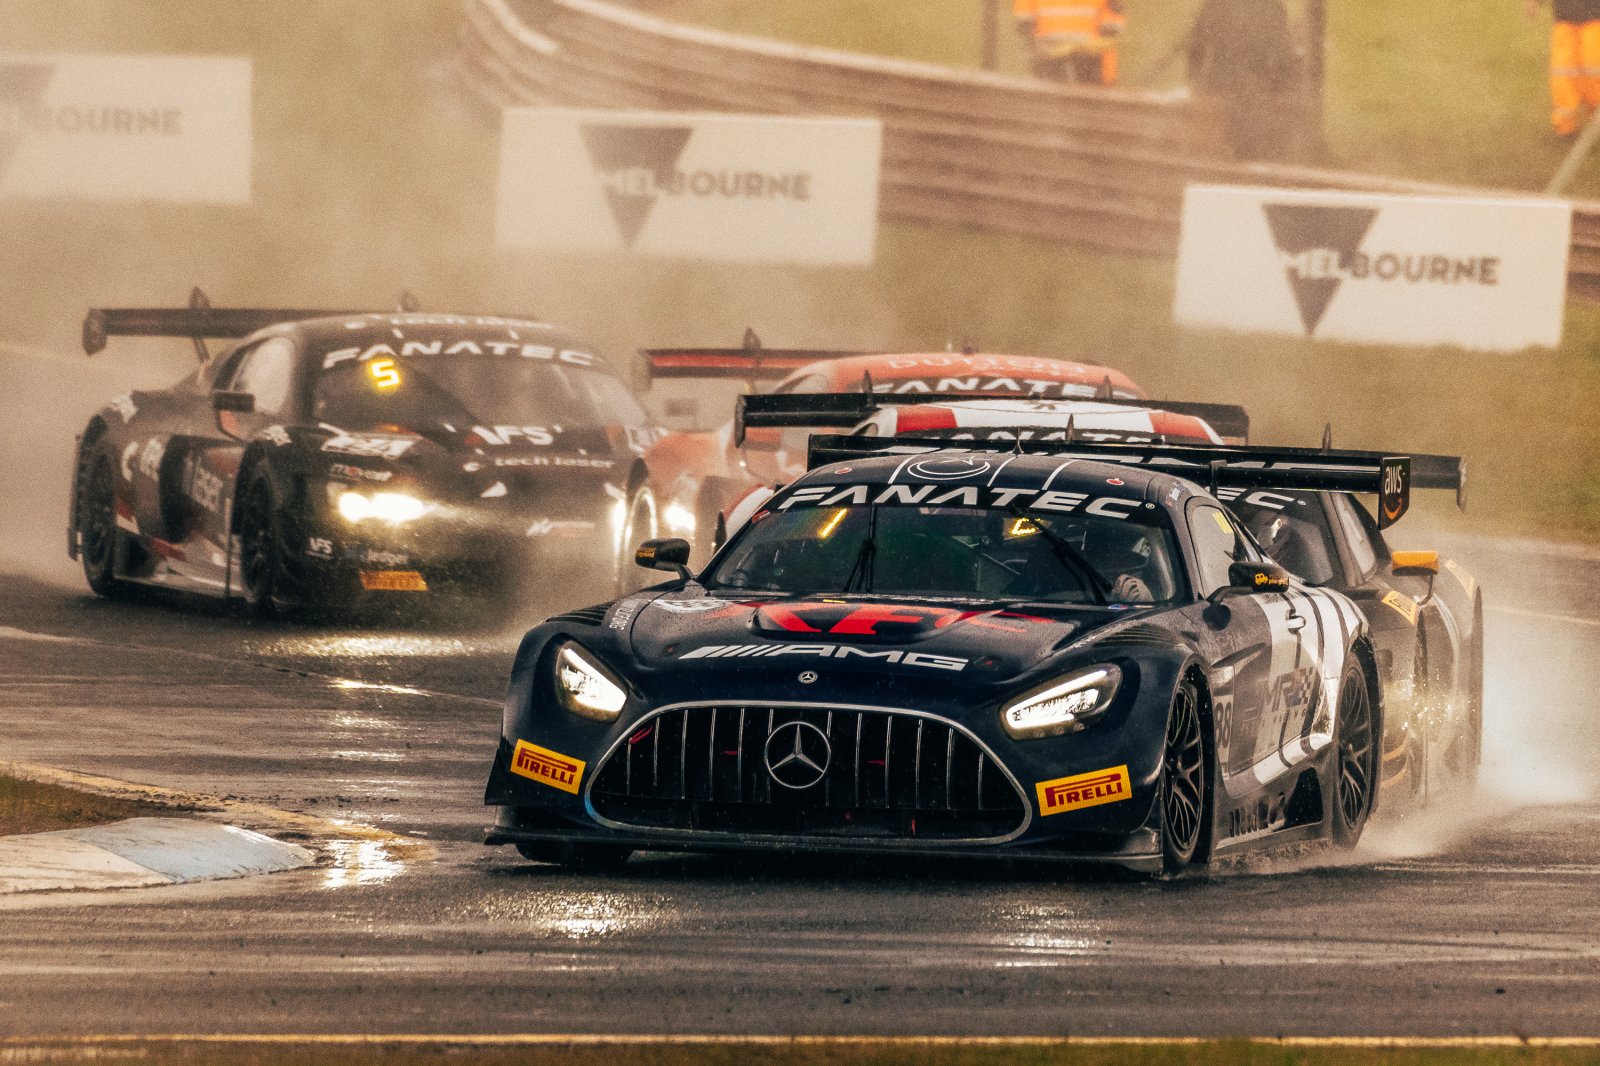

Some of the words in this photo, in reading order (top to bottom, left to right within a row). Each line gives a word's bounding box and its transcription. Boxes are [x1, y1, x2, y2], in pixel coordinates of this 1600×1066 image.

[322, 340, 593, 369] FANATEC
[1384, 464, 1403, 496] aws
[777, 483, 1144, 520] FANATEC
[772, 645, 969, 672] AMG
[516, 747, 578, 786] PIRELLI
[1044, 773, 1123, 808] PIRELLI
